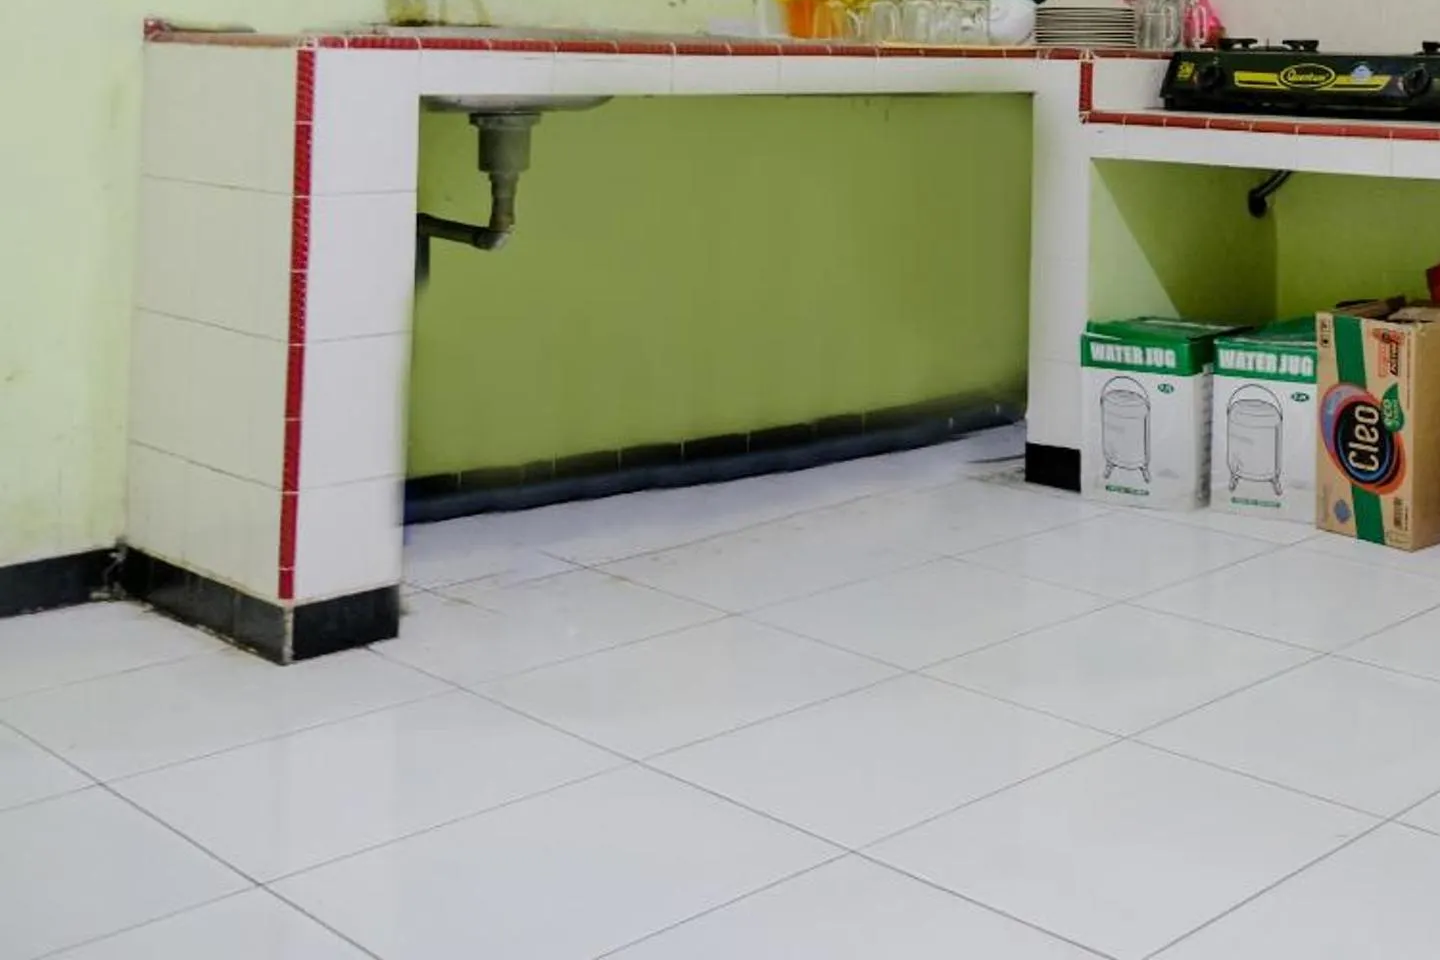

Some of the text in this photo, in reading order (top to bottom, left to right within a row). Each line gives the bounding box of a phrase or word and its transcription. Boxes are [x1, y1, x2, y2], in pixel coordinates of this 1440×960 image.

[1090, 341, 1177, 368] WATER JUG
[1218, 348, 1314, 377] WATER JUG
[1347, 404, 1380, 472] Cleo
